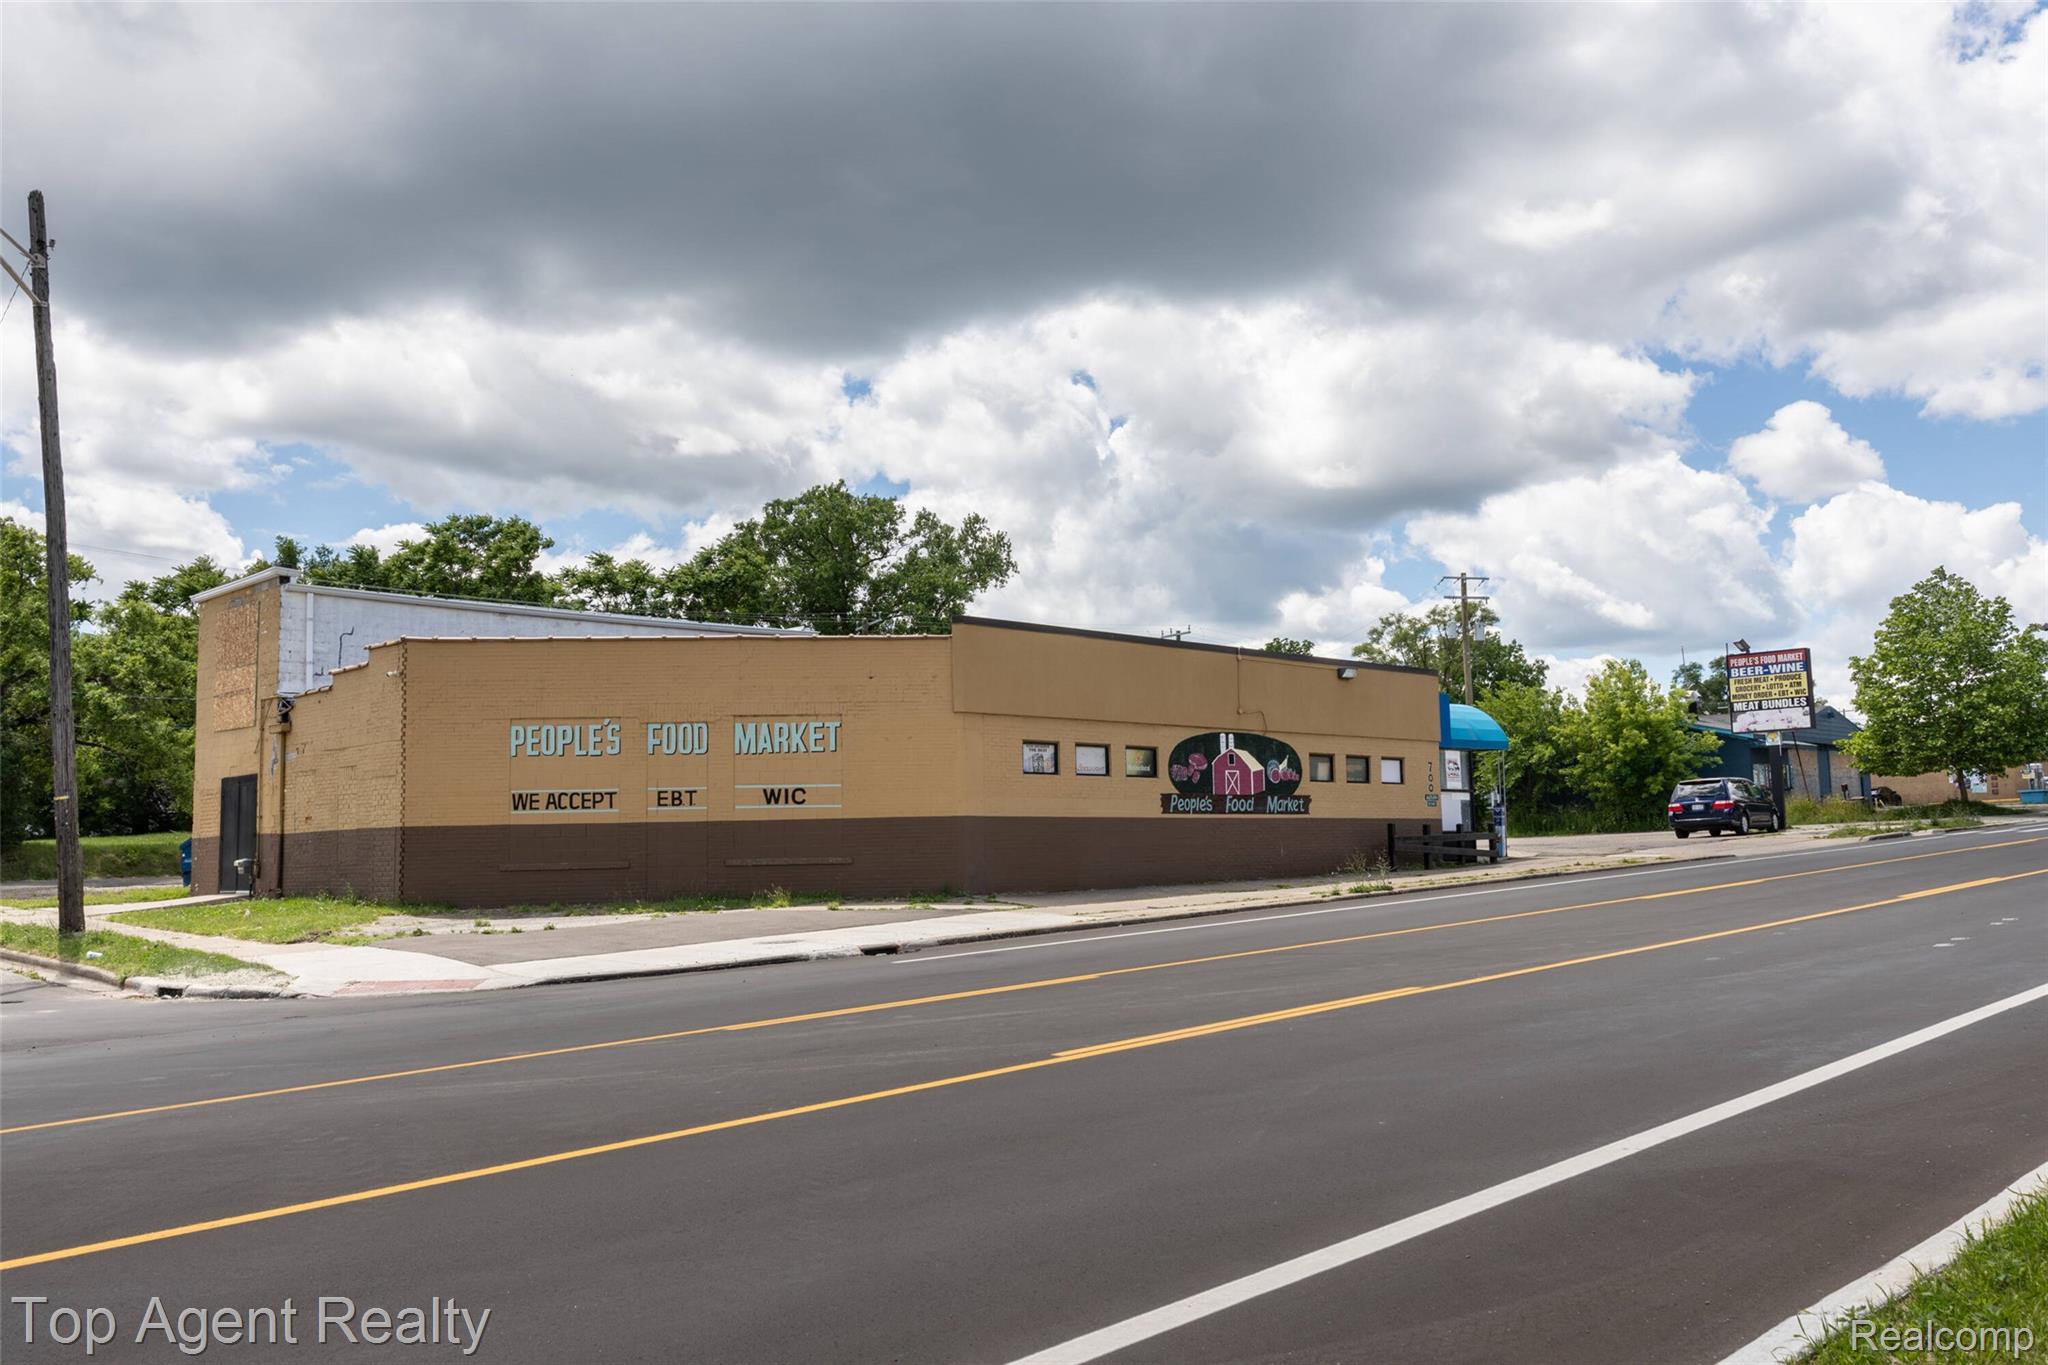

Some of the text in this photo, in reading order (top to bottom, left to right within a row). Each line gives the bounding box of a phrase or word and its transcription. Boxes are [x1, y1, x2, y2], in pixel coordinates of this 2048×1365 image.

[1730, 652, 1803, 667] PEOPLE'S FOOD MARKET
[1730, 662, 1804, 677] BEER-WINE
[1734, 673, 1802, 685] FRESH MEAT PRODUCE
[1735, 684, 1761, 693] GROCERY
[1766, 682, 1783, 690] LOTTO
[1732, 692, 1752, 700] MONEY
[1733, 697, 1807, 712] MEAT BUNDLES
[510, 718, 842, 757] PEOPLE'S FOOD MARKET
[512, 793, 540, 811] WE
[545, 792, 617, 810] ACCEPT
[762, 787, 807, 805] WIC
[1170, 794, 1305, 814] People's Food Market
